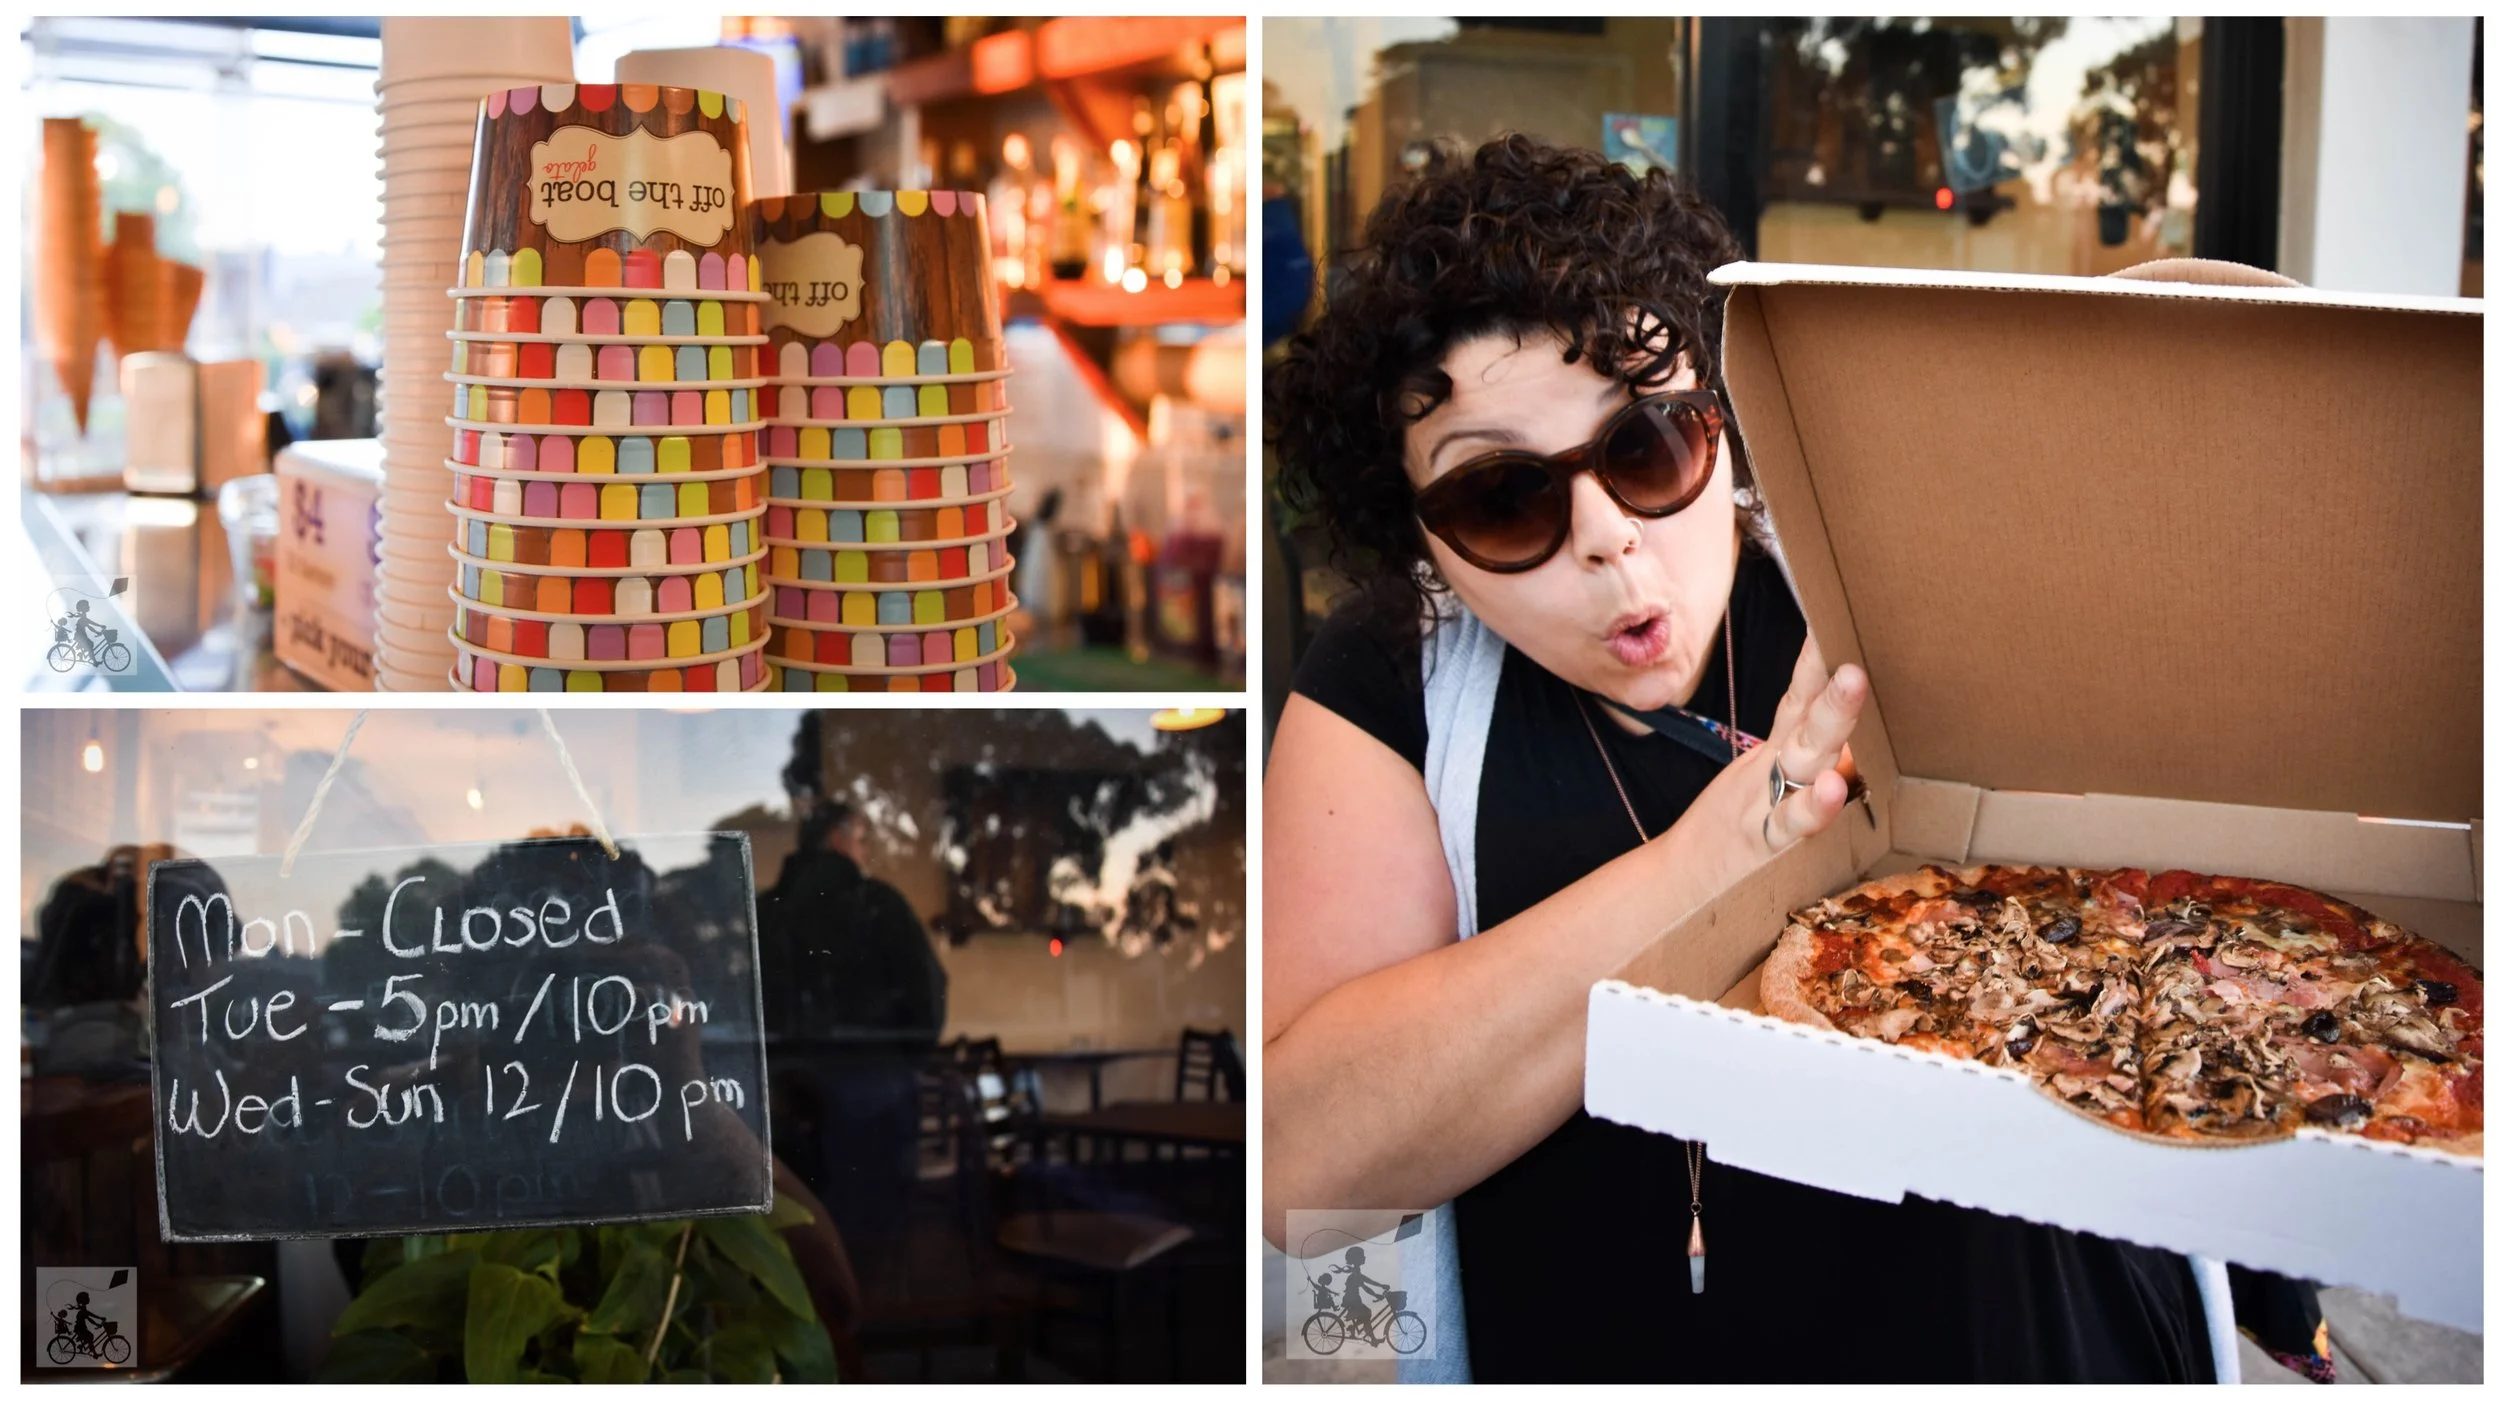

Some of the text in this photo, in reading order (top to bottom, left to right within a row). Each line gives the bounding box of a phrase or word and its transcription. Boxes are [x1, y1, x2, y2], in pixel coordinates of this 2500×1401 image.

[543, 144, 598, 184] gelato
[541, 180, 726, 213] off the boat
[805, 281, 848, 307] off
[175, 893, 316, 968] Mon
[170, 974, 307, 1046] Tue
